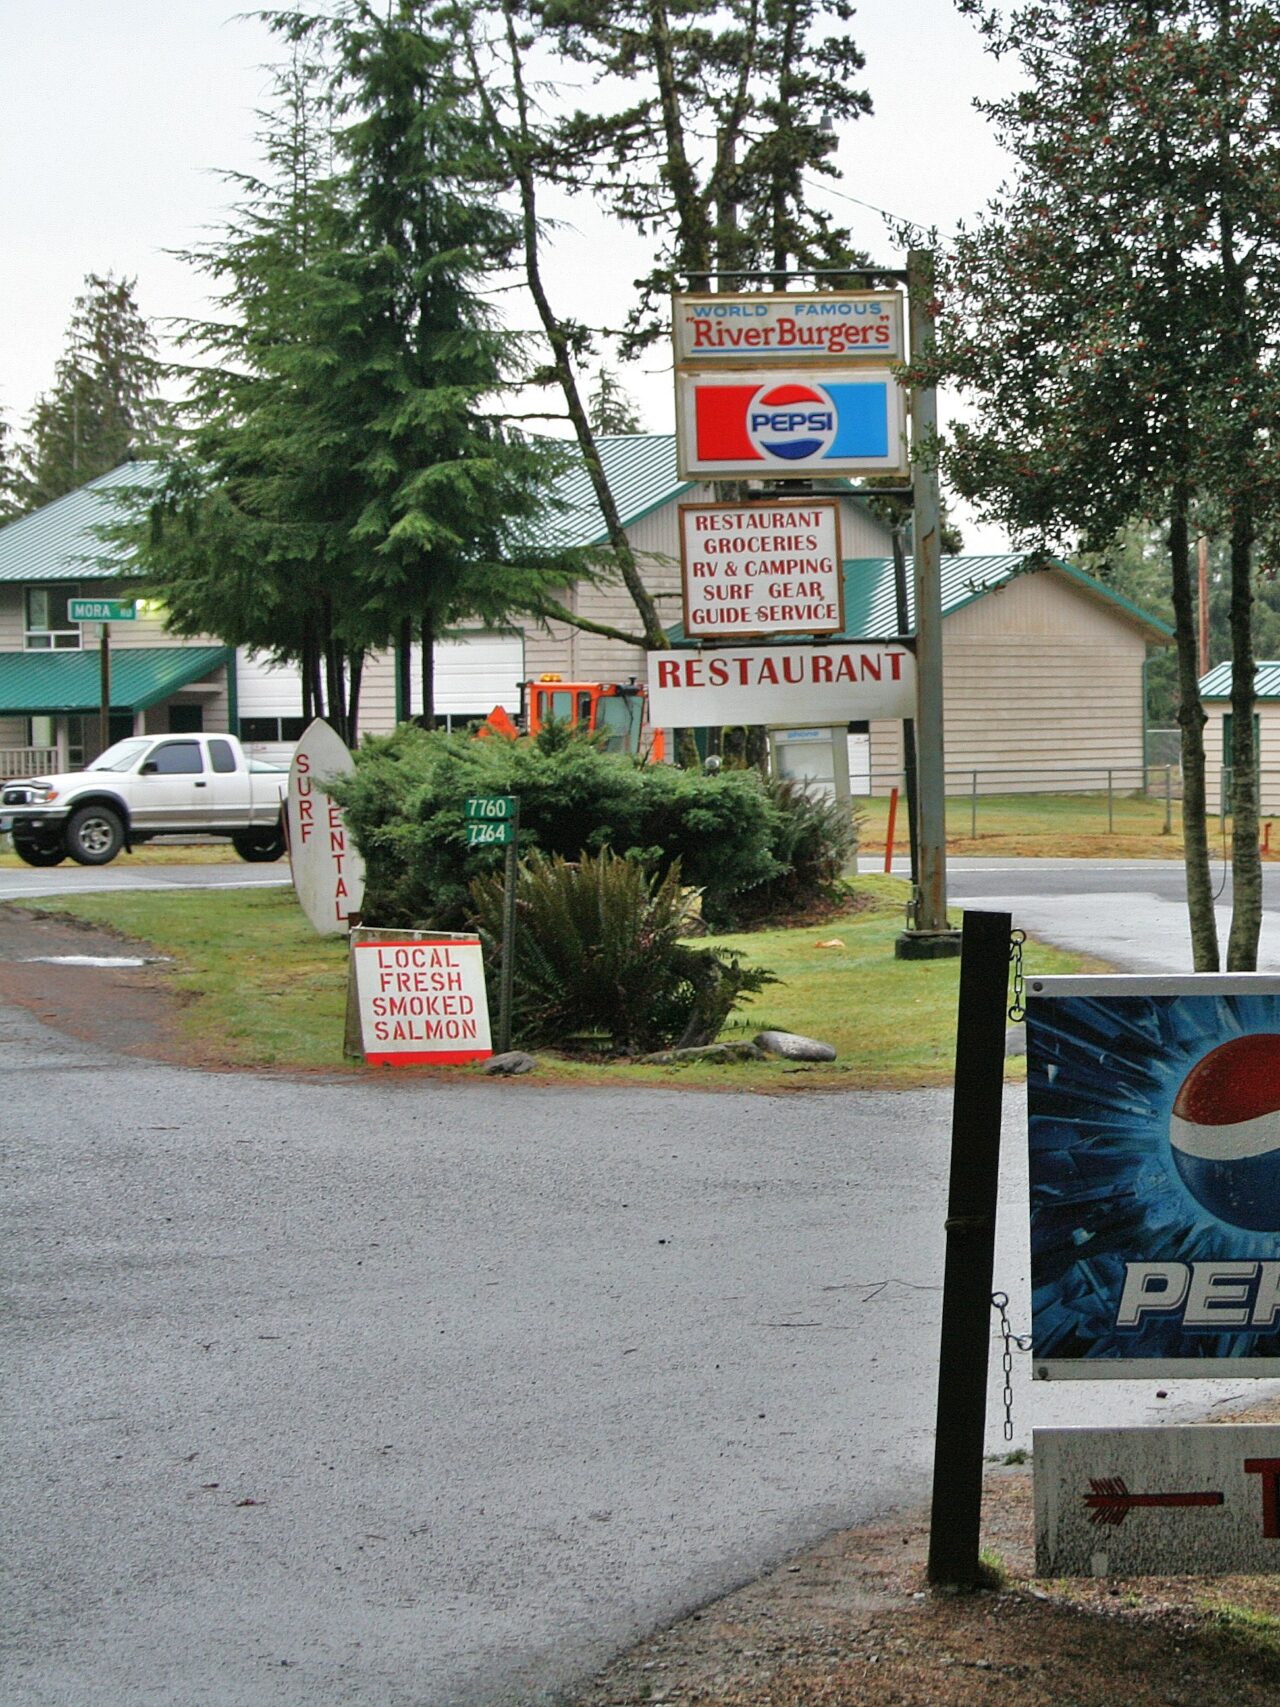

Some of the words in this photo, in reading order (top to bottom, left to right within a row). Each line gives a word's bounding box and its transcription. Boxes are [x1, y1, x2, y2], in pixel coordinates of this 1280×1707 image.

[693, 305, 769, 318] WORLD
[794, 303, 882, 316] FAMOUS
[751, 412, 833, 432] PEPSI
[695, 511, 823, 531] RESTAURANT
[703, 535, 818, 554] GROCERIES
[693, 562, 718, 577] RV
[724, 562, 738, 577] &
[744, 558, 833, 577] CAMPING
[703, 584, 754, 601] SURF
[75, 604, 111, 618] MORA
[691, 607, 752, 624] GUIDE
[657, 652, 906, 689] RESTAURANT
[296, 753, 314, 844] SURF
[468, 799, 506, 817] 7760
[468, 824, 505, 842] 7764
[326, 792, 350, 921] ENTAL
[377, 948, 460, 969] LOCAL
[380, 972, 462, 993] FRESH
[372, 995, 474, 1017] SMOKED
[374, 1019, 477, 1041] SALMON
